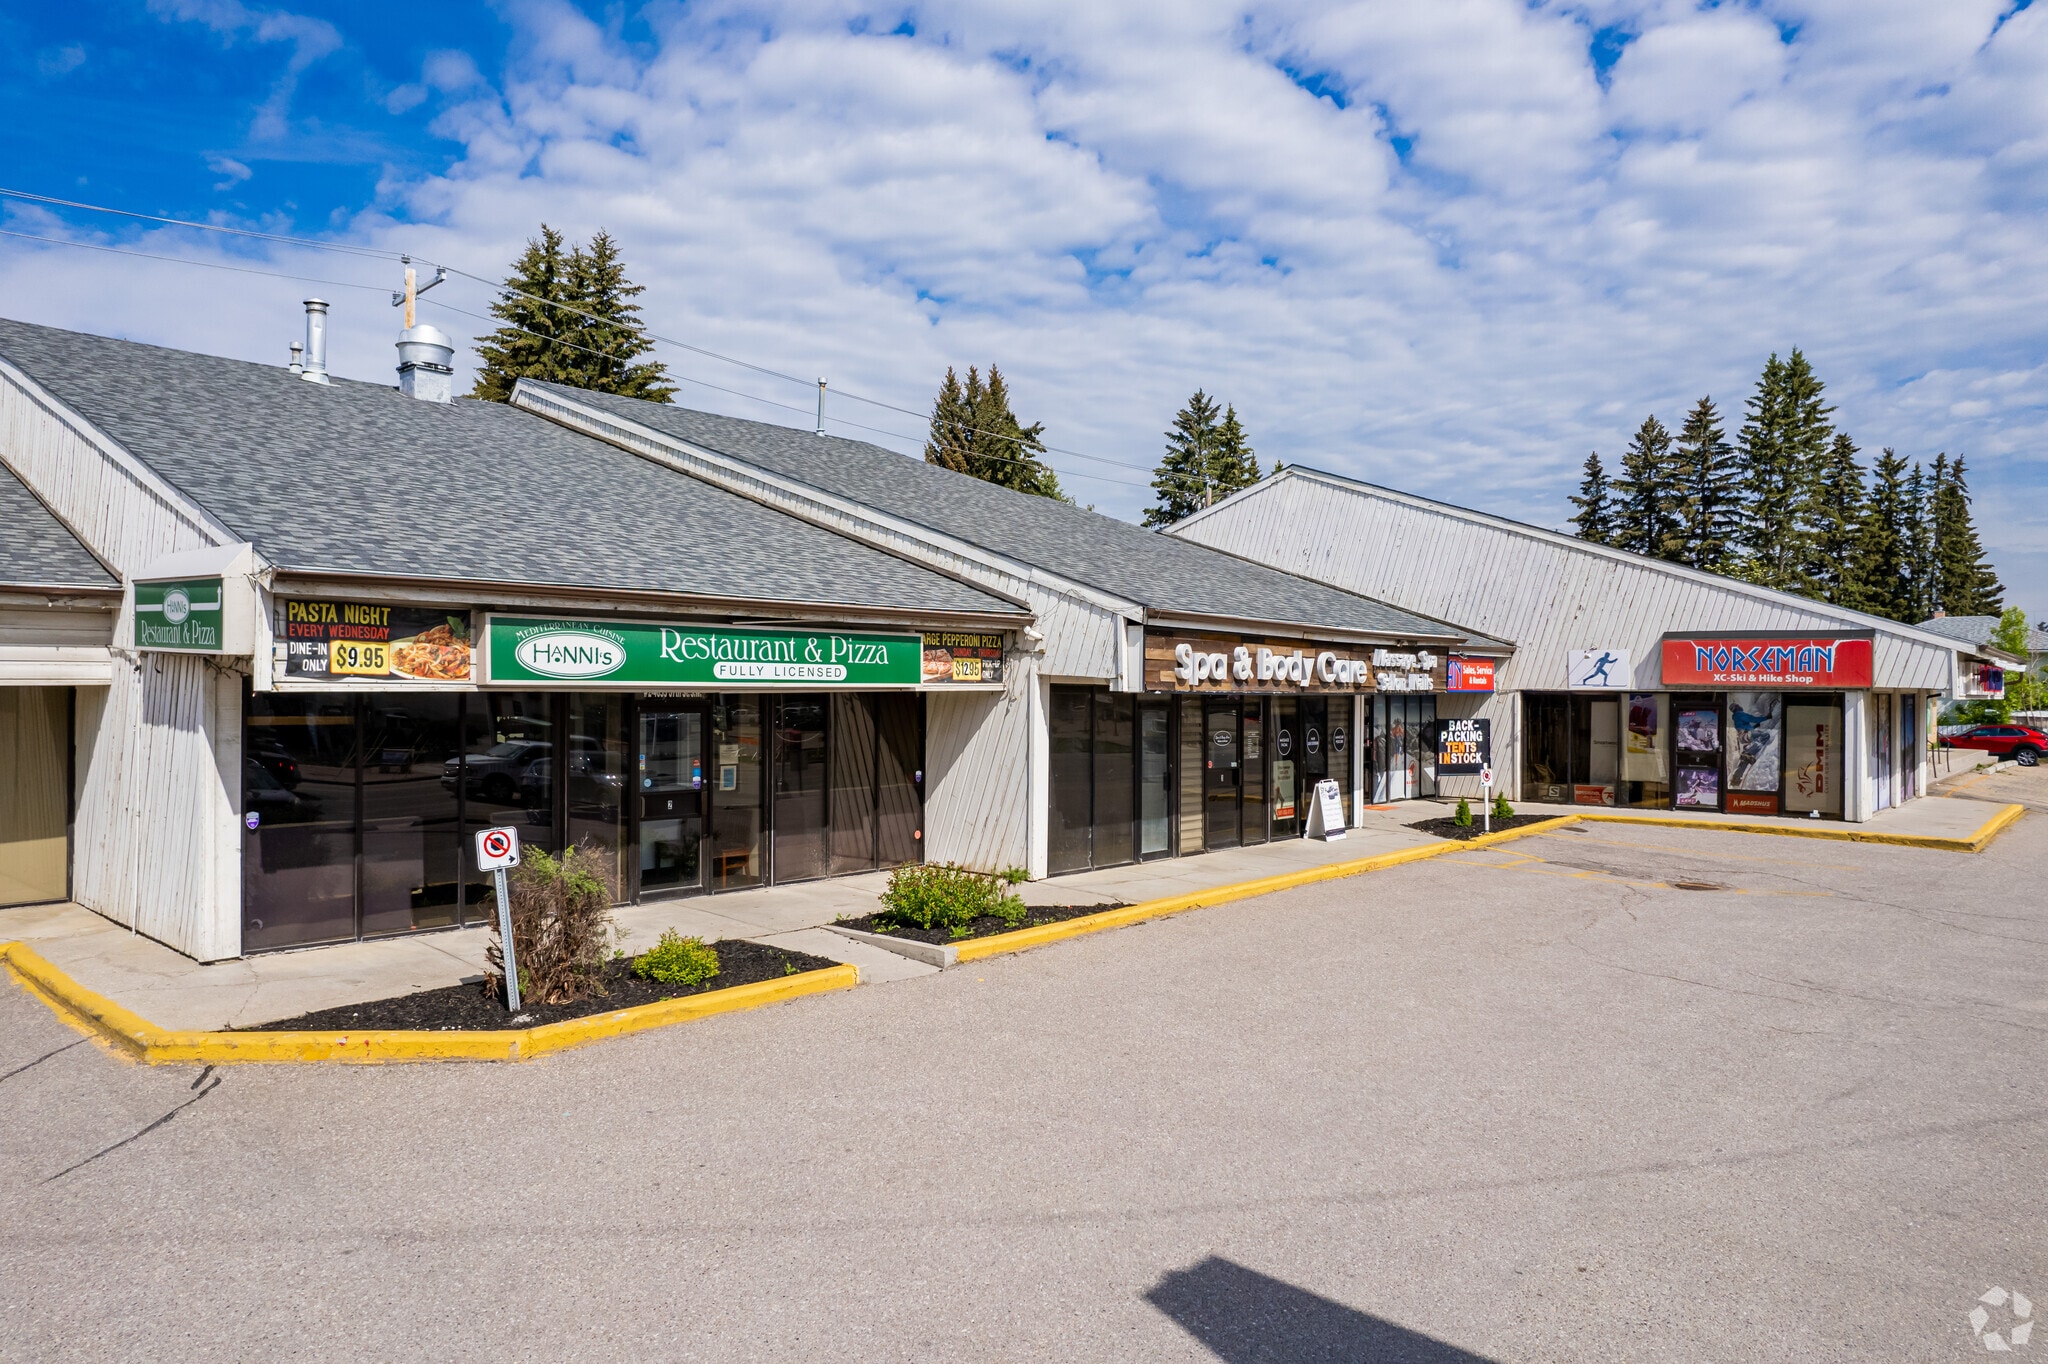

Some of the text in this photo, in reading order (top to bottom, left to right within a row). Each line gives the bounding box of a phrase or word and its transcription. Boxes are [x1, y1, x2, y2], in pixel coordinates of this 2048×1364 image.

[289, 602, 391, 626] PASTA NIGHT
[142, 620, 216, 645] Restaurant & Pizza
[290, 624, 389, 640] EVERY WEDNESDAY
[659, 628, 889, 665] Restaurant & Pizza
[942, 633, 980, 647] PEPPERONI
[981, 635, 1002, 648] PIZZA
[290, 642, 327, 655] DINE-IN
[952, 648, 972, 657] SUNDAY
[337, 644, 384, 669] $9.95
[1696, 646, 1832, 673] NORSEMAN
[302, 659, 328, 671] ONLY
[720, 665, 842, 678] FULLY LICENSED
[1175, 643, 1367, 687] Spa & Body Care
[1462, 664, 1493, 676] Sales, Service
[1472, 677, 1487, 685] Rentals
[1713, 673, 1814, 684] XC-Ski & Hike Shop
[1449, 720, 1480, 731] BACK-
[1440, 730, 1483, 742] PACKING
[1446, 742, 1477, 753] TENTS
[1816, 724, 1824, 793] DMM
